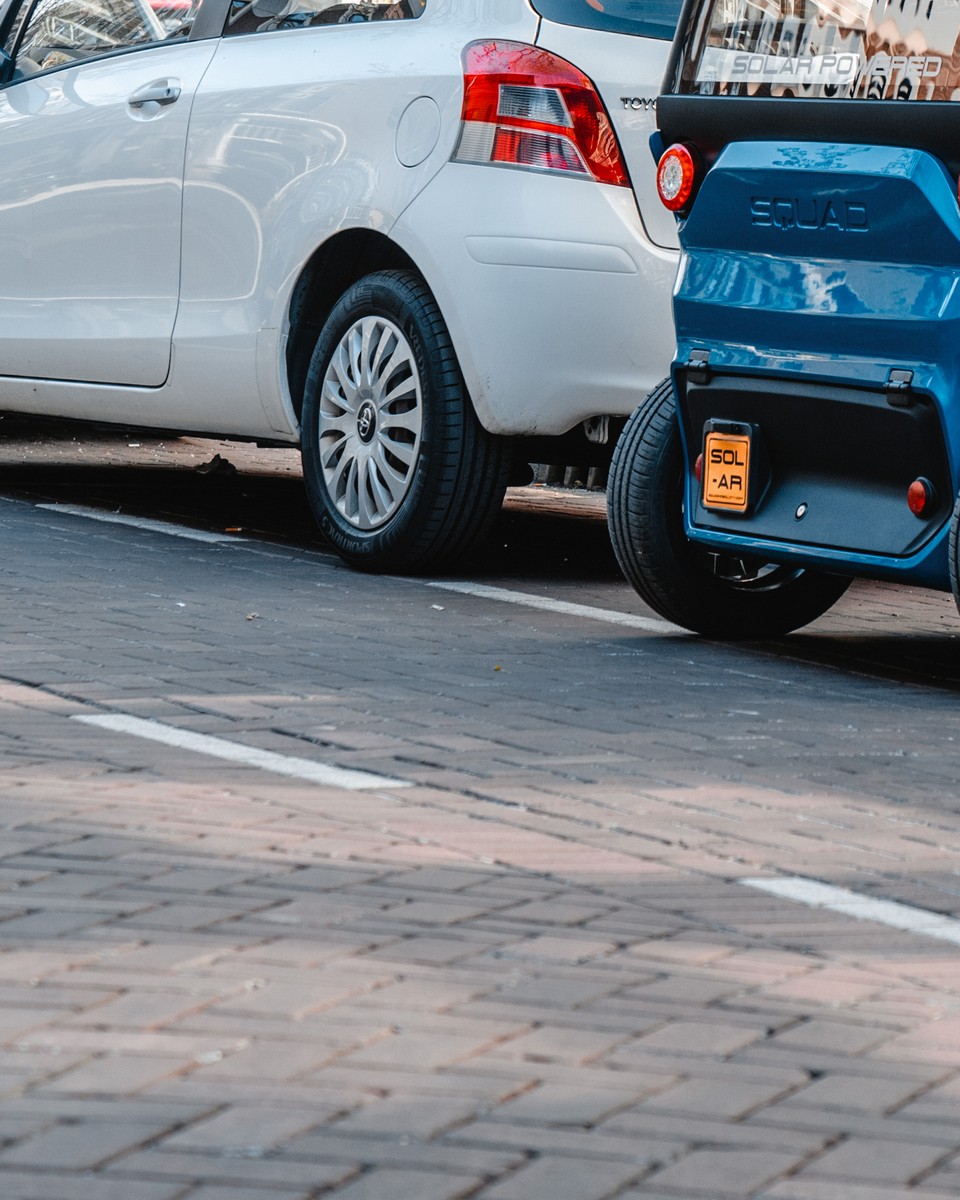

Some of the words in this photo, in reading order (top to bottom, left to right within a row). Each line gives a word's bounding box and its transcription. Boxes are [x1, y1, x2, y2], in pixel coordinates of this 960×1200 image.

[731, 55, 813, 75] SOLAR
[819, 55, 943, 78] POWERED
[750, 195, 869, 232] SQUAD
[711, 448, 744, 466] SOL
[712, 474, 742, 491] -AR
